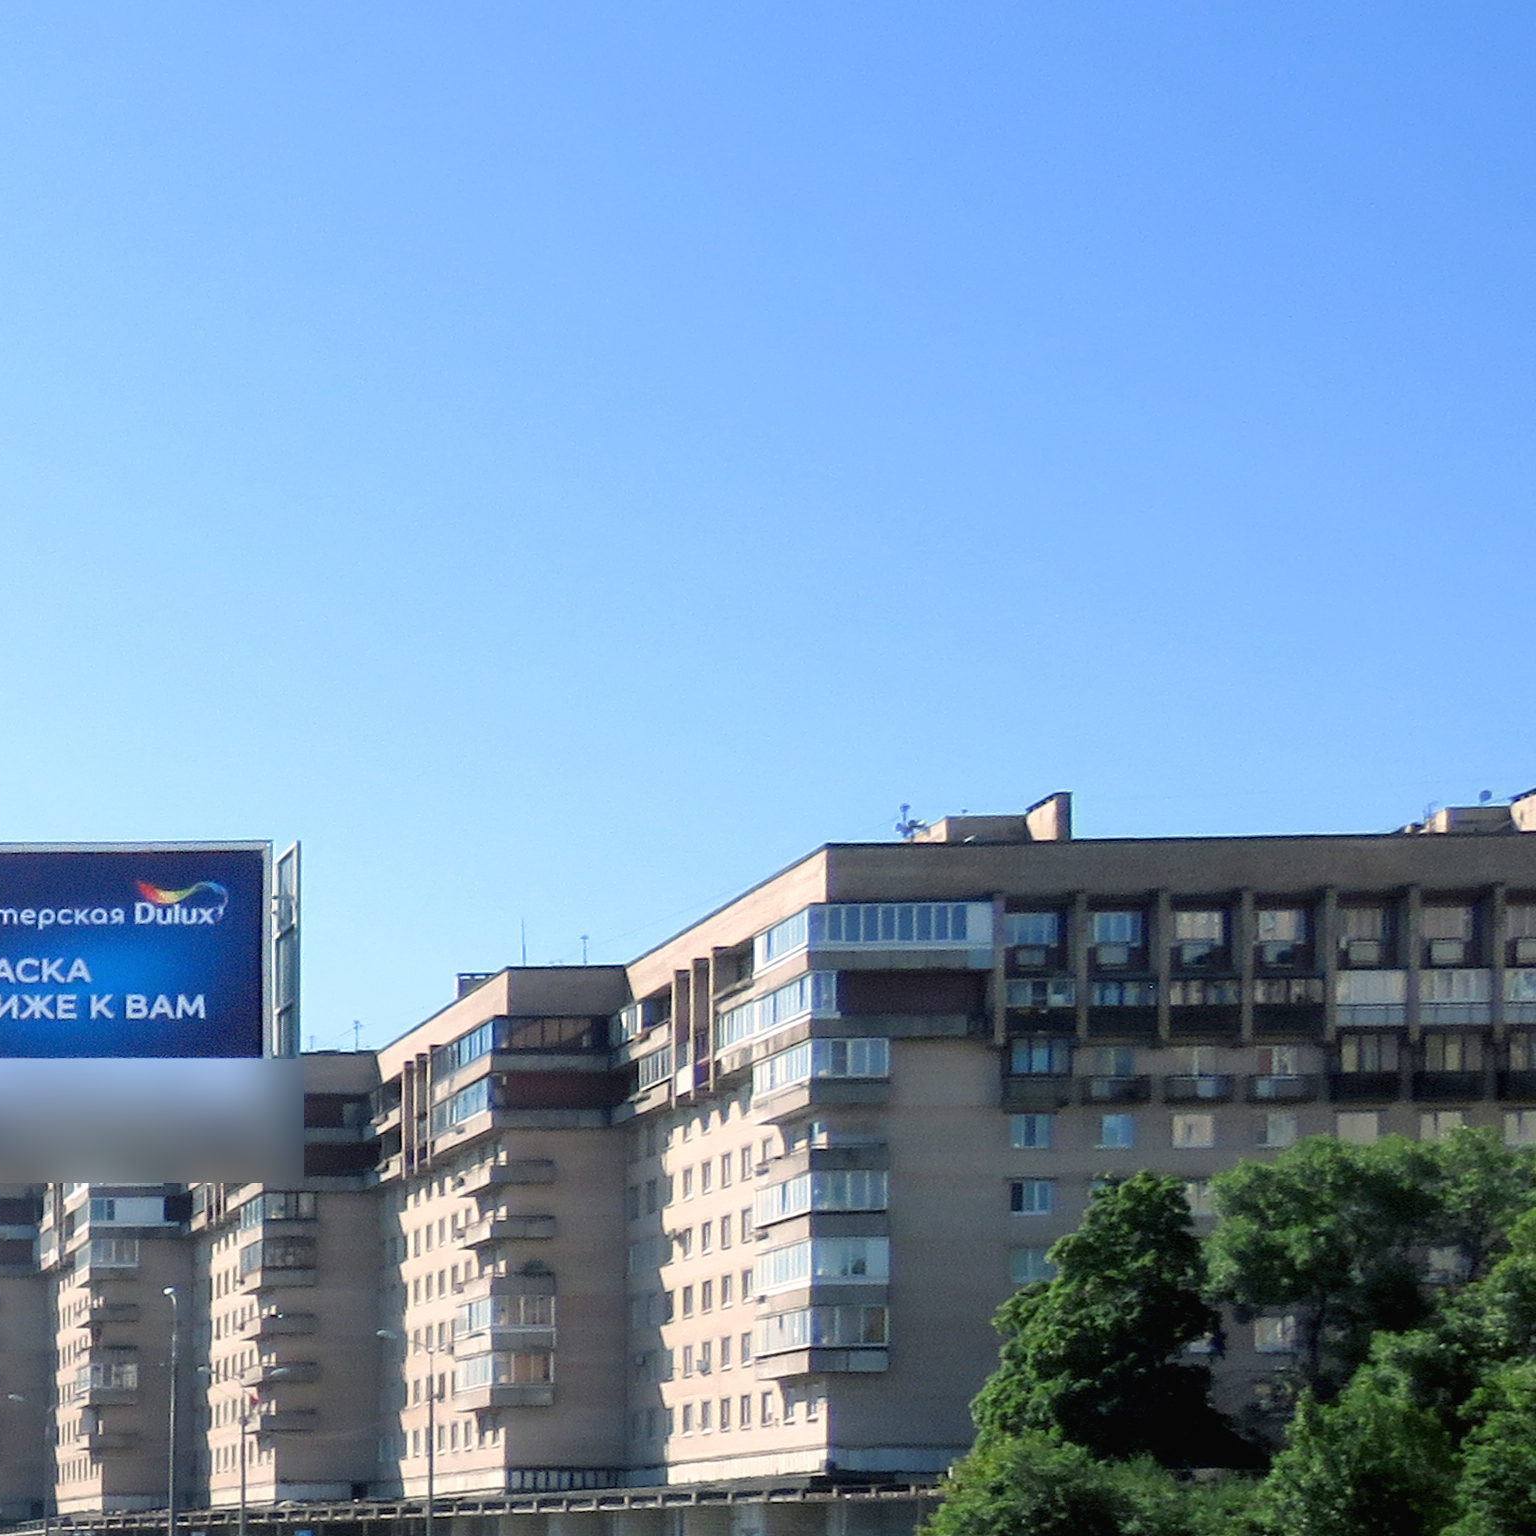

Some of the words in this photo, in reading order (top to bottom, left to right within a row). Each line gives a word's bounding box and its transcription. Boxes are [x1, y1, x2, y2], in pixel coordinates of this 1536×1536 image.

[134, 901, 215, 925] Dulux
[89, 994, 115, 1020] К
[125, 994, 207, 1020] ВАМ
